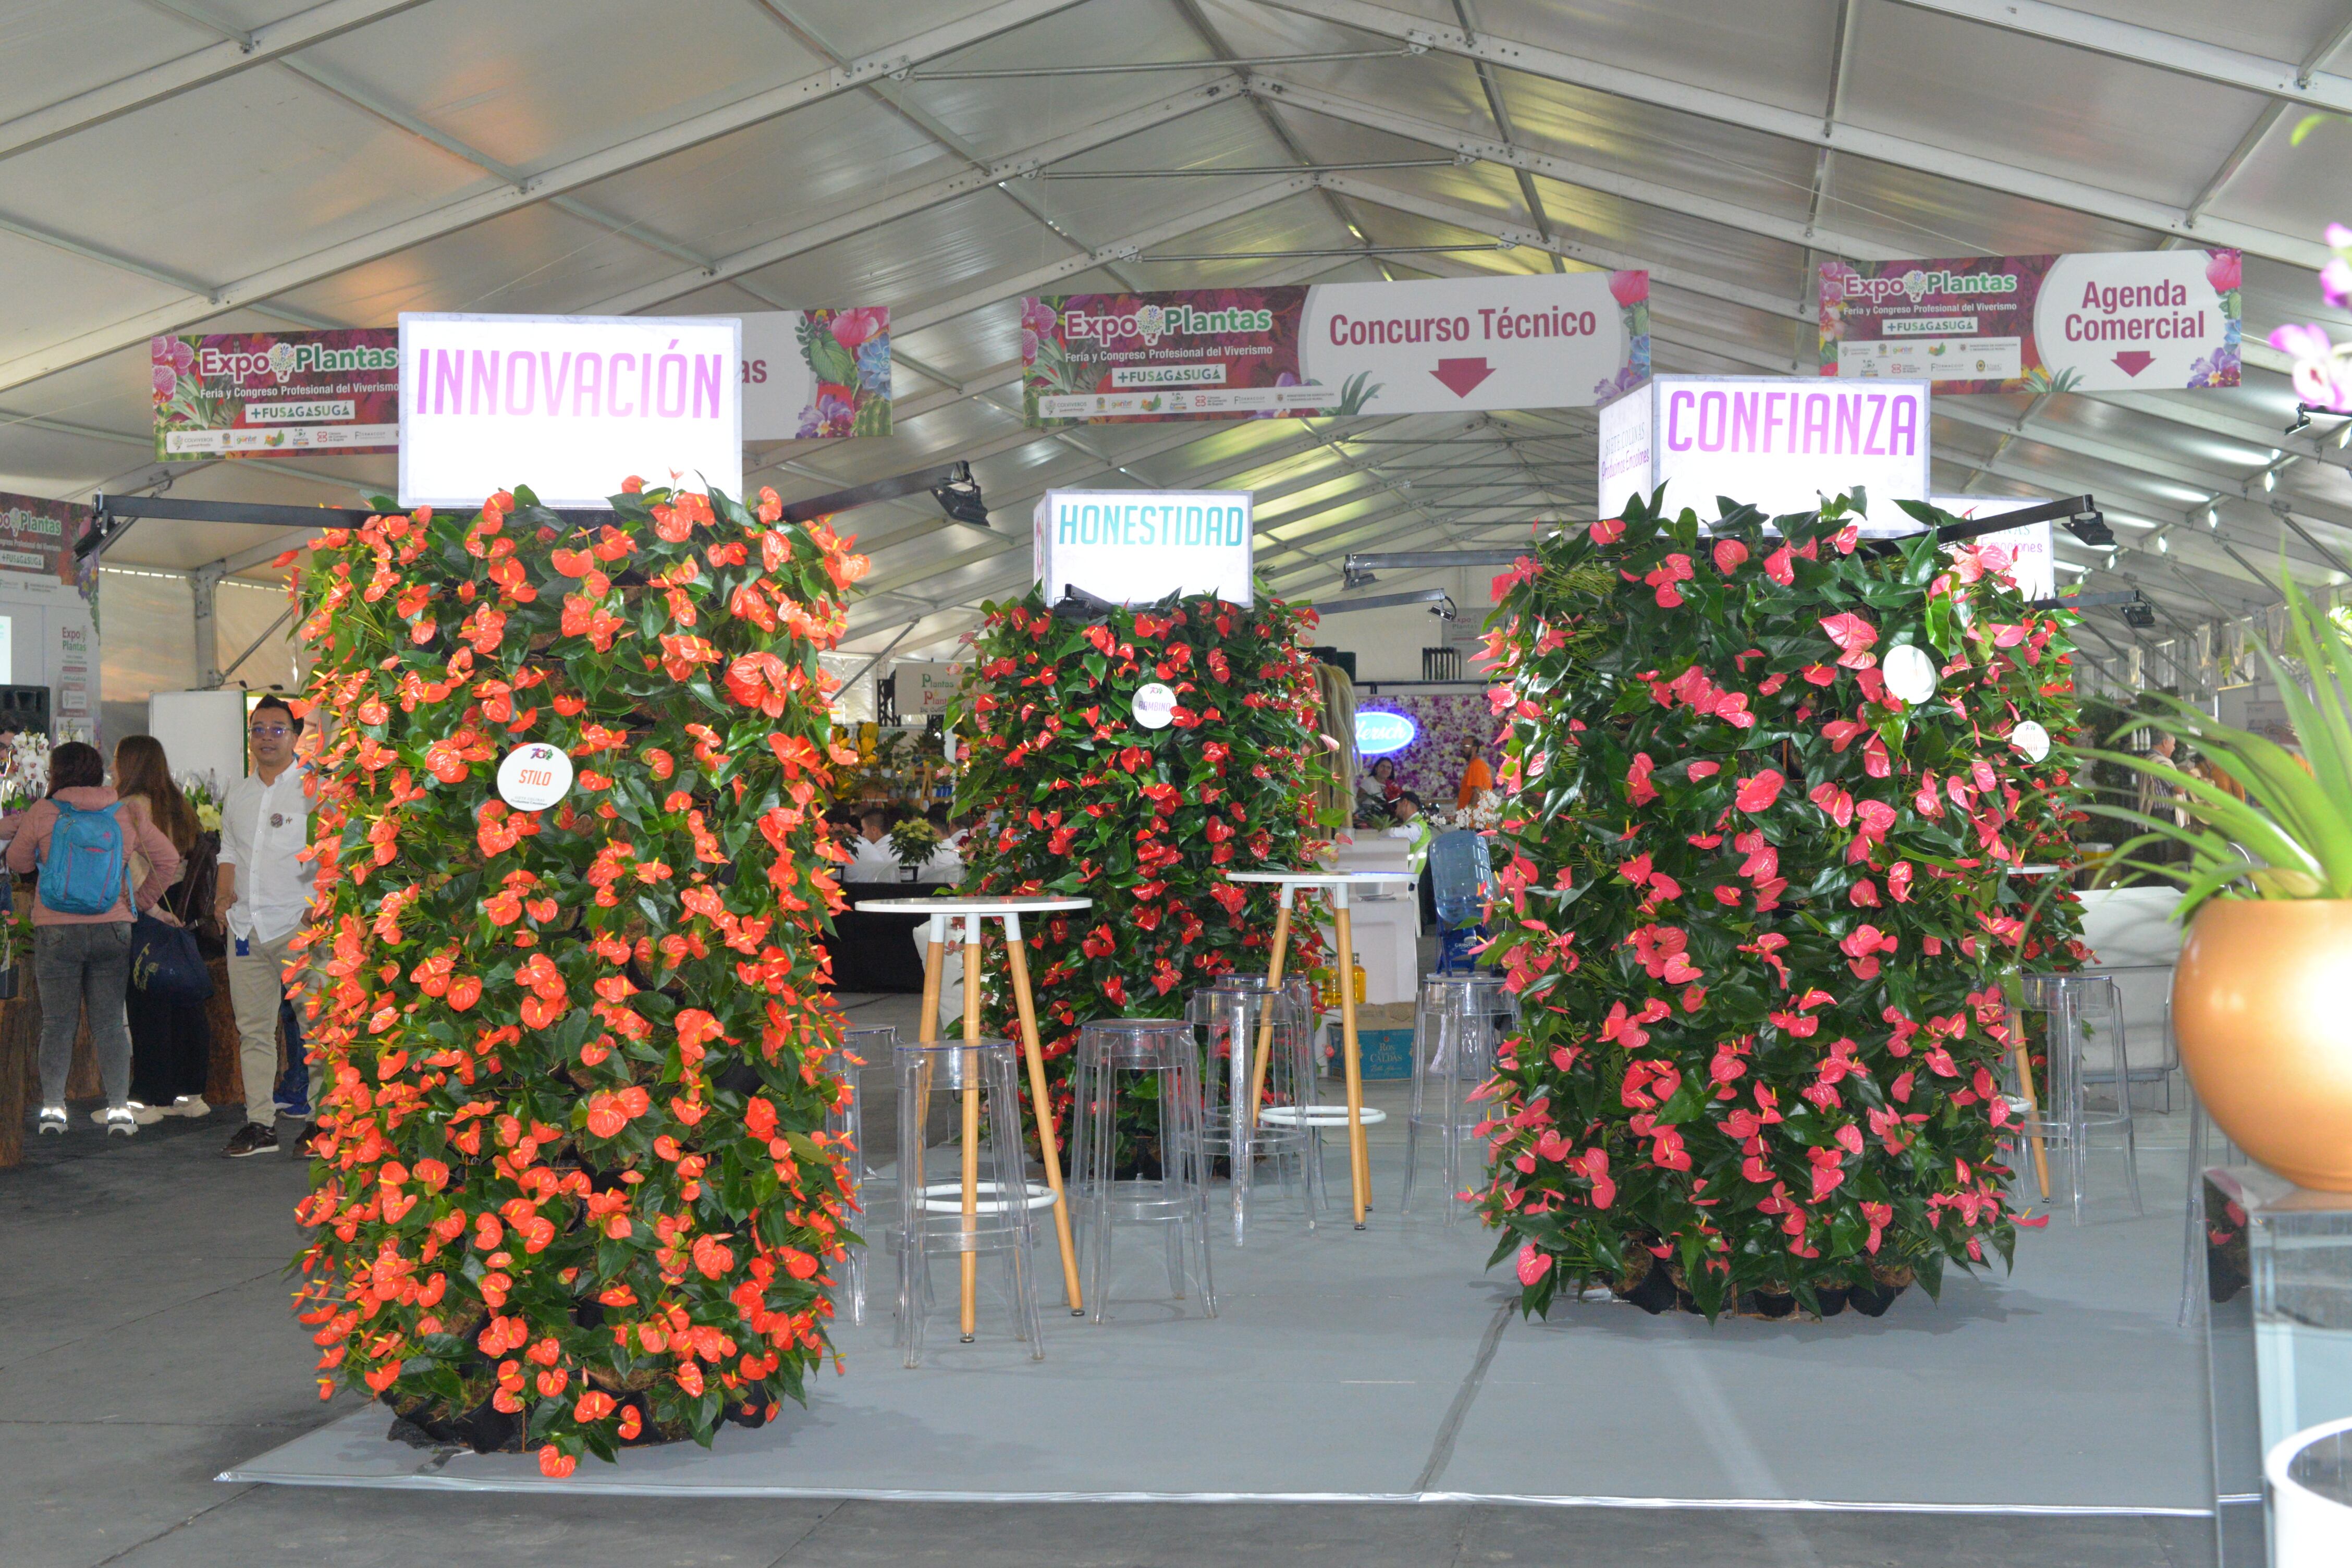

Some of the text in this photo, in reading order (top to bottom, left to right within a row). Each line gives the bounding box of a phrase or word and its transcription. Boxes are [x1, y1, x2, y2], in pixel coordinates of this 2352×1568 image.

[1845, 272, 2016, 302] Expo Plantas
[2082, 279, 2186, 314] Agenda
[1844, 307, 1864, 315] Feria
[1873, 305, 1910, 315] Congreso
[1914, 303, 1959, 313] Profesional
[1962, 302, 1974, 311] del
[1977, 302, 2017, 311] Viverismo
[1067, 308, 1270, 346] Expo Plantas
[1330, 306, 1596, 346] Concurso Técnico
[2065, 311, 2204, 342] Comercial
[201, 346, 397, 381] Expo Plantas
[1065, 346, 1272, 363] Feria y Congreso Profesional del Viverismo
[201, 383, 399, 399] Feria y Congreso Profesional del Viverismo
[417, 339, 722, 419] INNOVACIÓN
[1668, 390, 1917, 456] CONFIANZA
[1606, 422, 1645, 457] SIETE COLINAS
[1602, 448, 1649, 481] Producimos Emociones
[20, 512, 61, 535] Plantas
[1059, 505, 1243, 546] HONESTIDAD
[63, 627, 80, 641] Expo
[63, 641, 86, 651] Plantas
[922, 673, 954, 688] Plantas
[1139, 701, 1170, 712] BAMBINO
[519, 769, 552, 787] STILO
[1370, 1054, 1402, 1062] CALDAS
